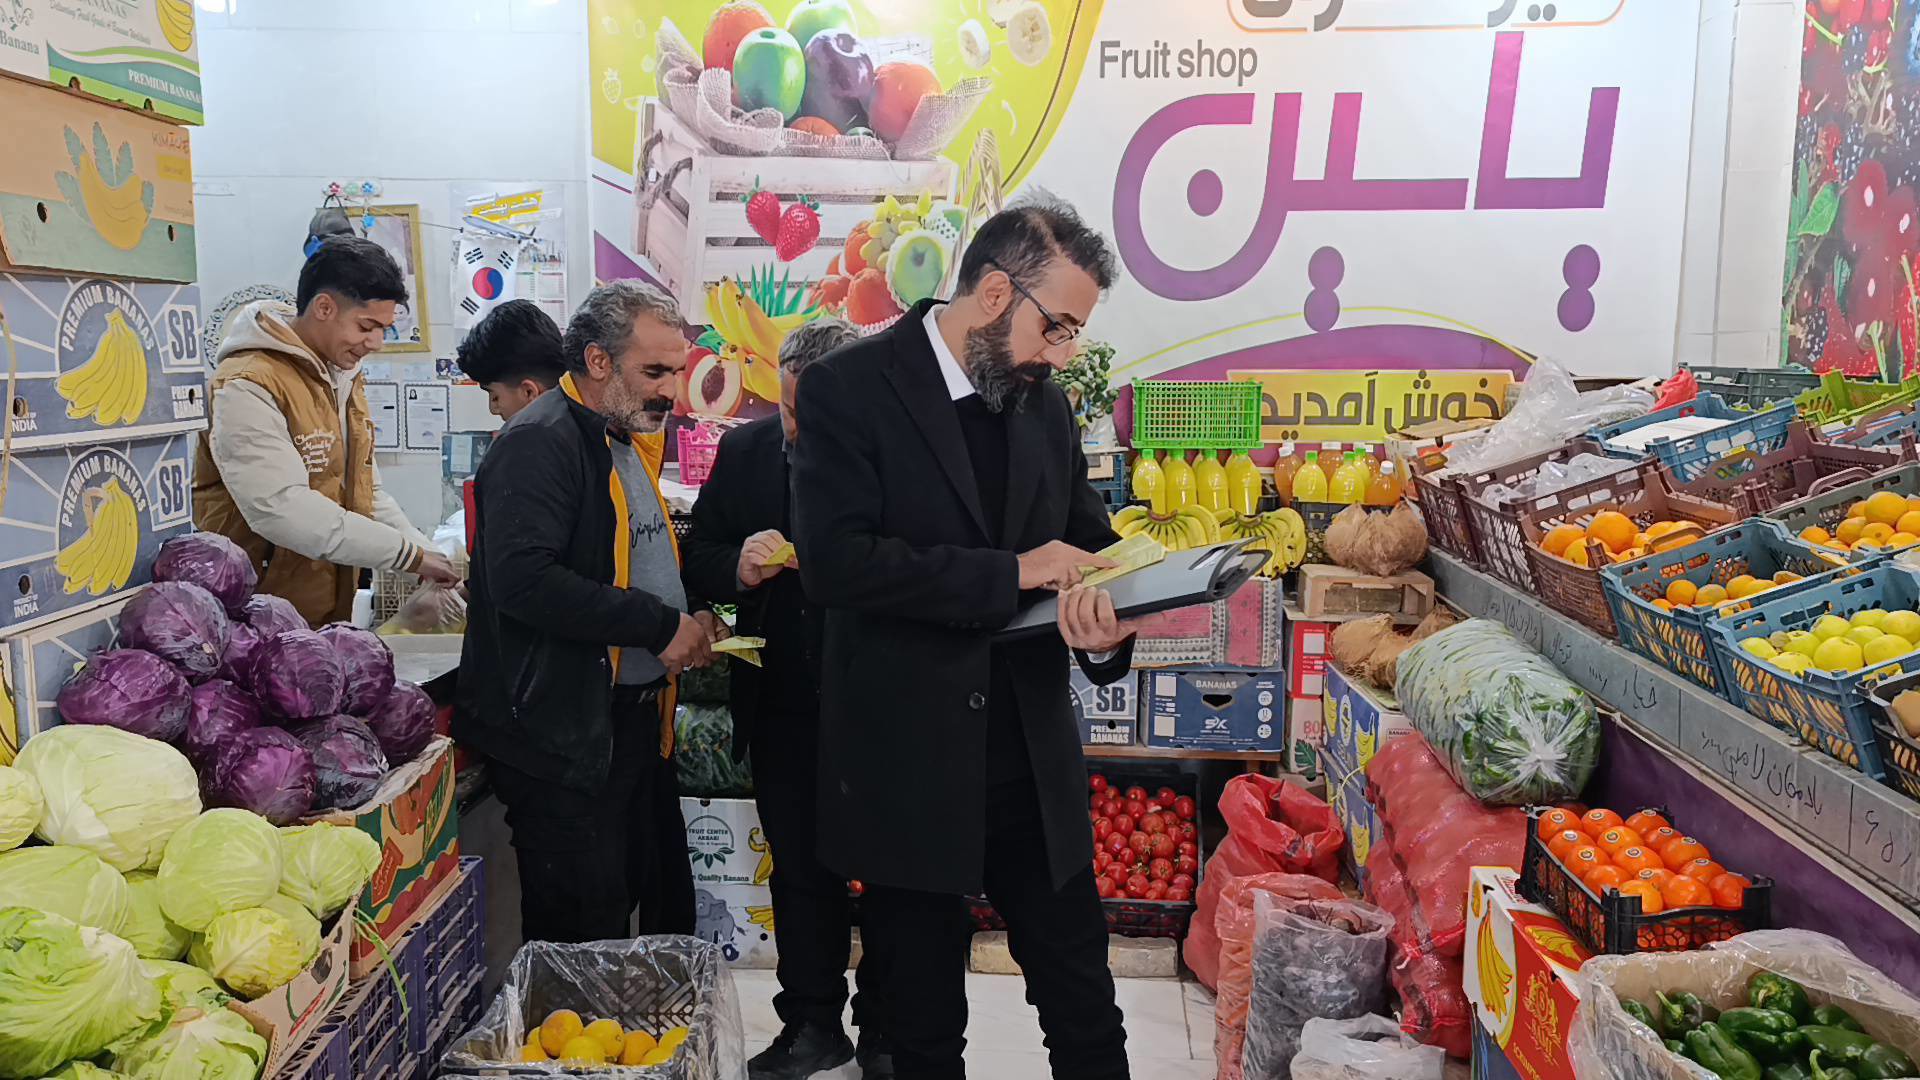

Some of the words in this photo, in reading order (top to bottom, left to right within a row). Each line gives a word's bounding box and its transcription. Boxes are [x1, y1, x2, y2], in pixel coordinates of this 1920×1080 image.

[1099, 40, 1170, 79] Fruit
[1177, 40, 1258, 86] shop
[128, 68, 169, 93] PREMIUM
[61, 284, 104, 352] PREMIUM
[106, 284, 156, 351] BANANAS
[167, 308, 198, 363] SB
[11, 418, 38, 432] NDIA
[61, 455, 101, 528] PREMIUM
[103, 454, 149, 513] BANANAS
[158, 463, 184, 516] SB
[14, 601, 39, 618] INDIA
[1194, 679, 1238, 689] BANANAS
[1096, 686, 1126, 712] SB
[1090, 733, 1129, 744] BANANAS
[723, 874, 749, 882] Banana
